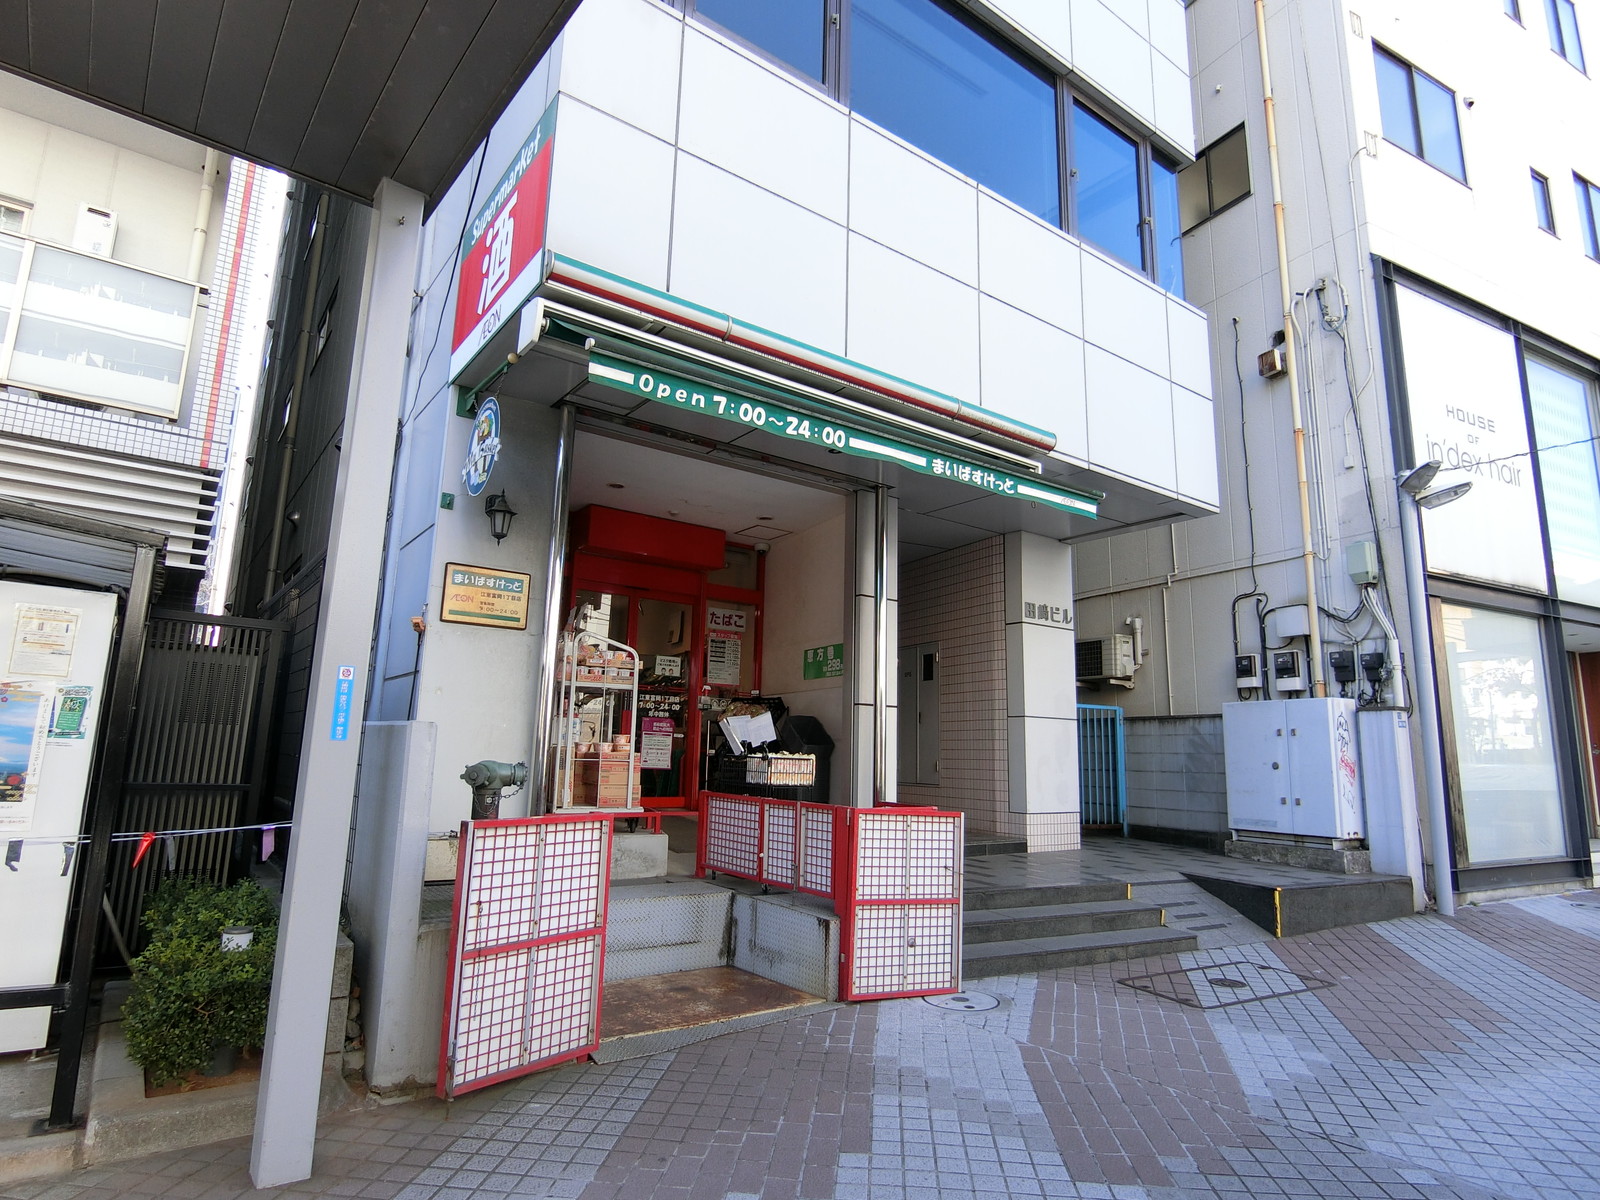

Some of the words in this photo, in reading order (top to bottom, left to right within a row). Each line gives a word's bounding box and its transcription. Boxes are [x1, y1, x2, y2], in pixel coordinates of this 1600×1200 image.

[470, 124, 542, 246] Supermarket
[476, 190, 518, 315] 酒
[638, 373, 706, 408] Open
[1445, 404, 1496, 433] HOUSE
[1467, 434, 1480, 445] OF
[932, 457, 1016, 495] まいばすけっと
[1488, 453, 1521, 487] hair
[453, 573, 522, 591] まいばすけっと
[710, 611, 744, 628] たばこ
